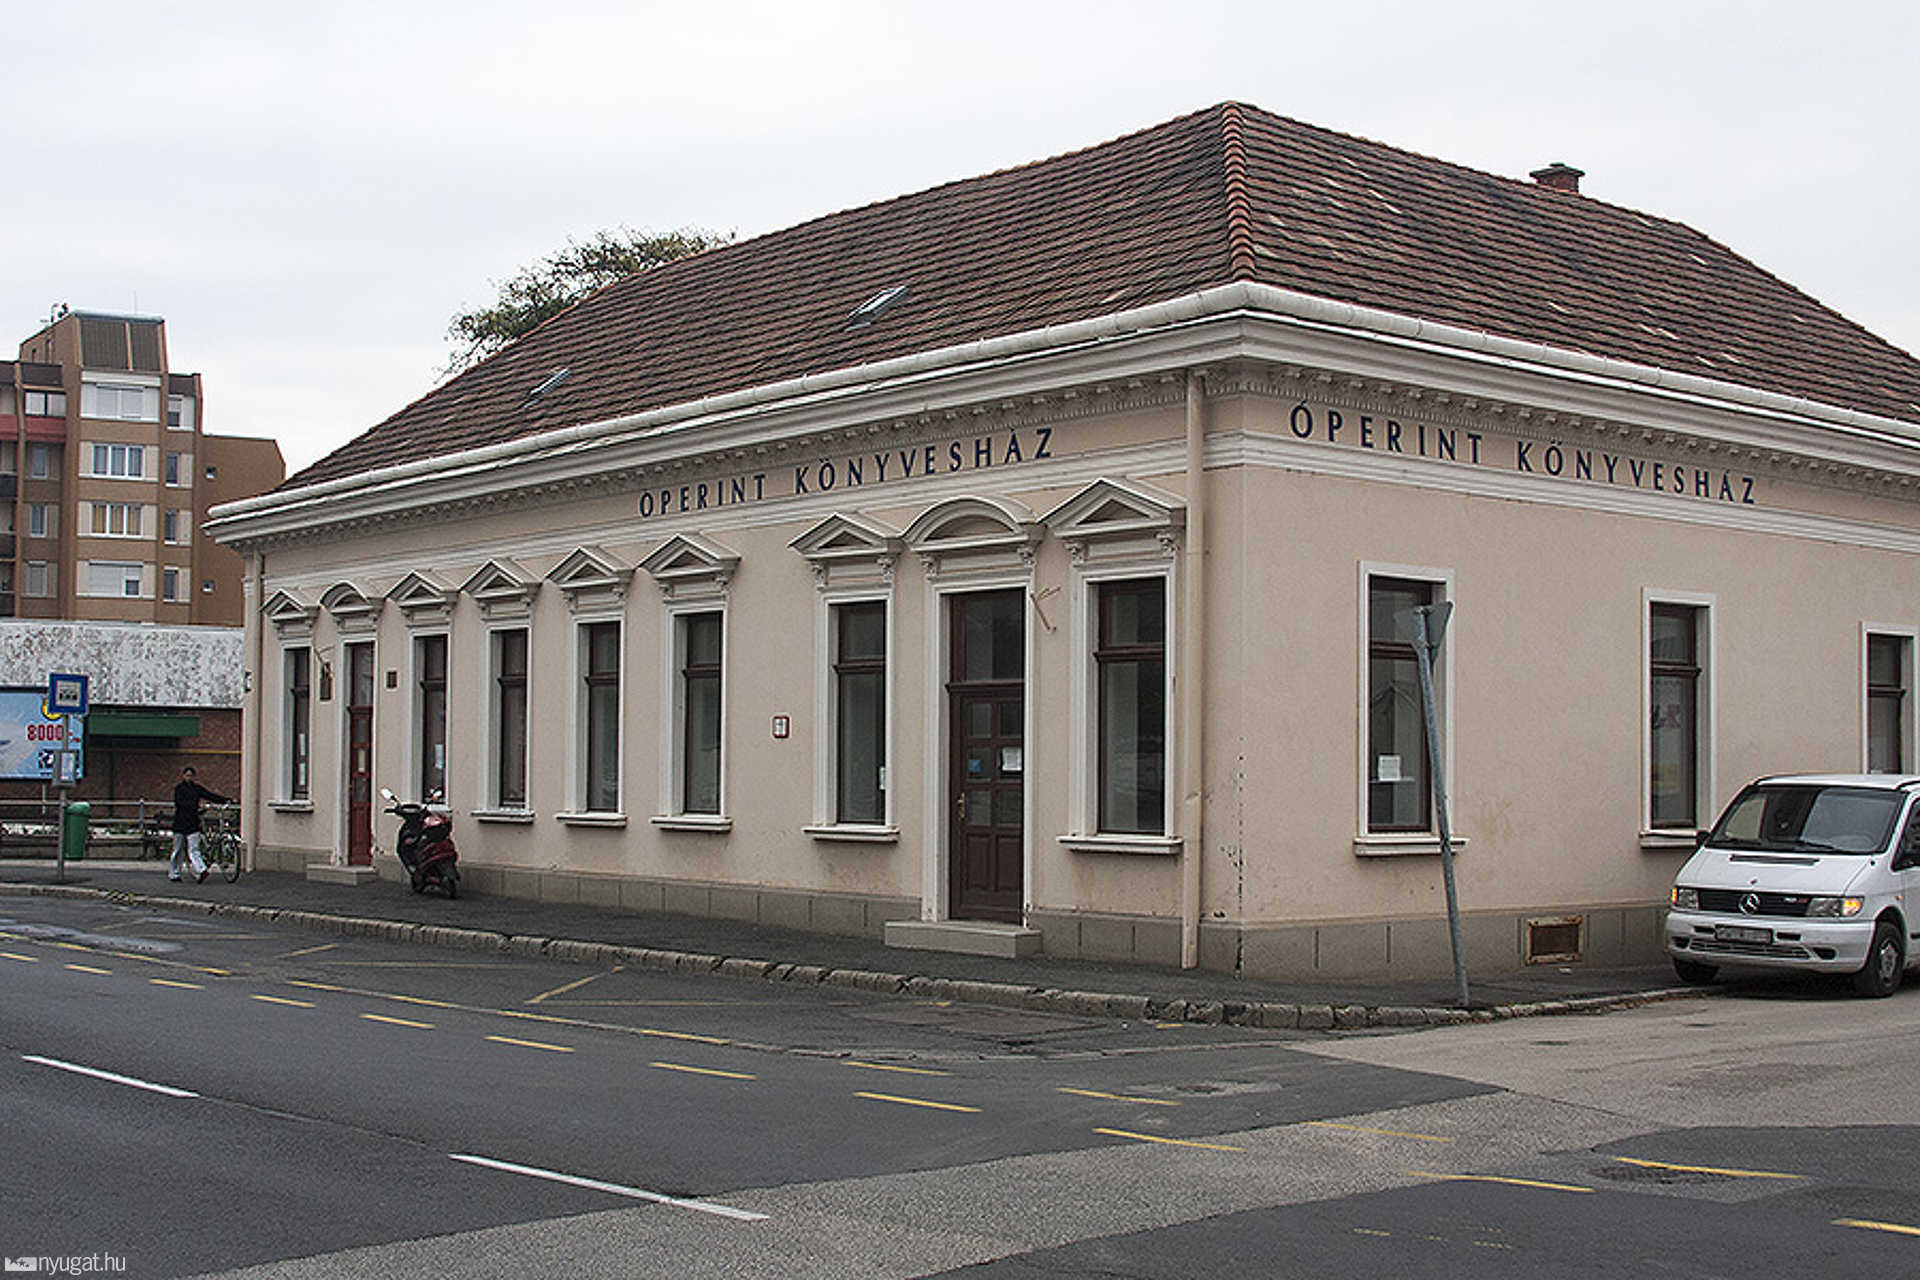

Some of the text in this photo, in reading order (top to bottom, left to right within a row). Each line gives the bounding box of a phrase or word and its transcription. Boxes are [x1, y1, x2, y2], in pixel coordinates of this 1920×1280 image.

[795, 427, 1052, 495] KÖNYVESHÁZ
[1290, 400, 1755, 504] ÓPERINT KÖNYVESHÁZ
